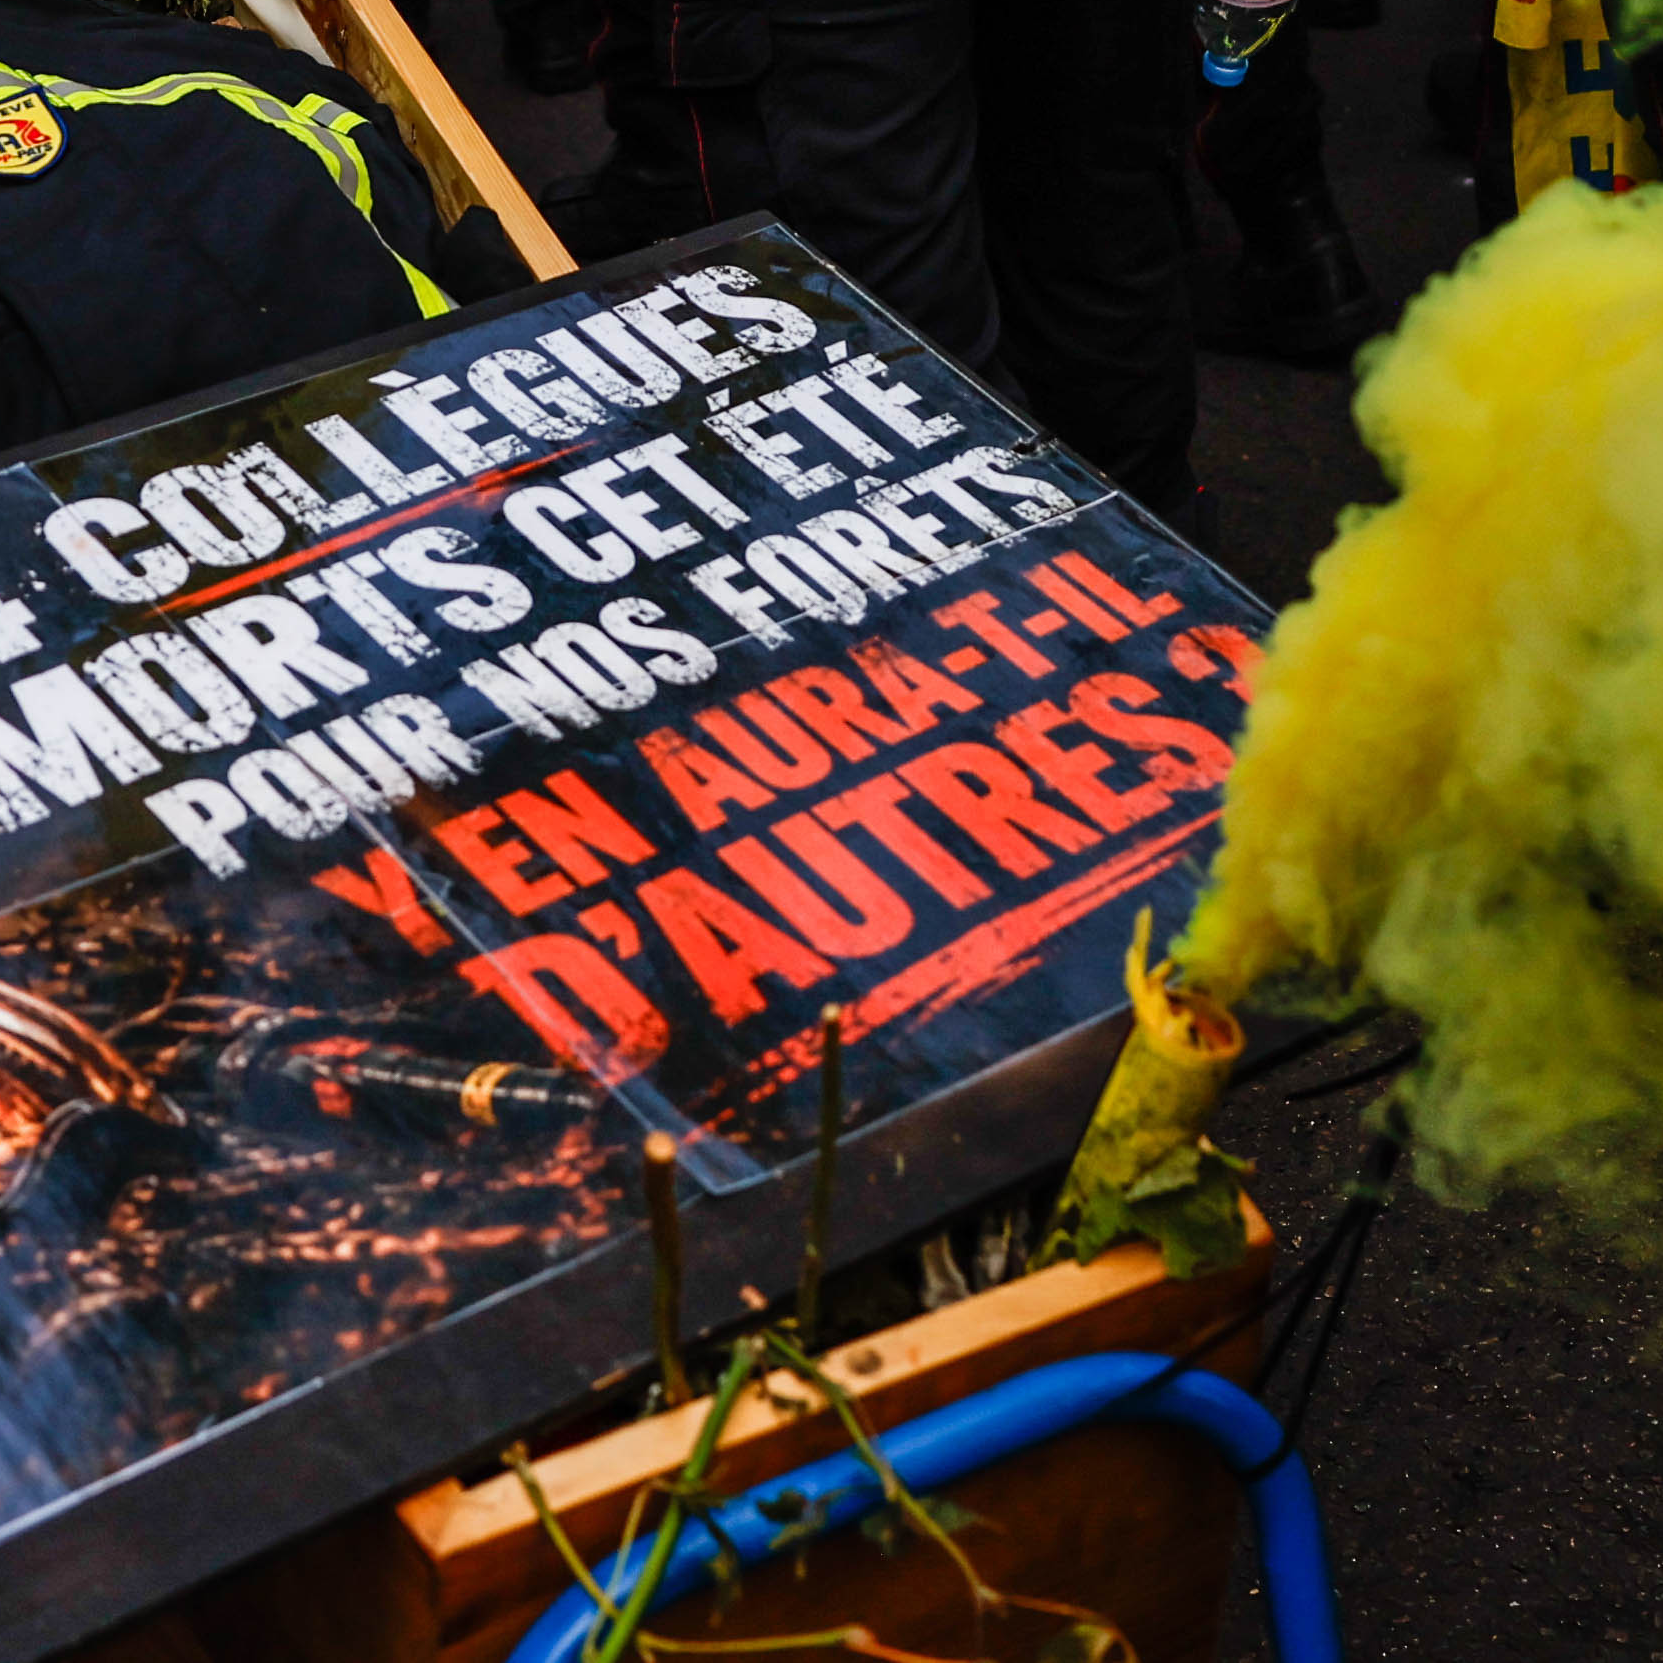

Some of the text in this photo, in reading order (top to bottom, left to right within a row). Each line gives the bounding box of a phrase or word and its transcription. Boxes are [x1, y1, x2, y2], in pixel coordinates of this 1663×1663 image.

[43, 263, 818, 604] COLLÈGUES
[504, 433, 749, 585] CET
[704, 342, 967, 501] ÉTÉ
[143, 444, 1078, 881] POUR NOS FORÊTS
[311, 549, 1185, 956] Y EN AURA-T-IL
[456, 671, 1236, 1086] D'AUTRES
